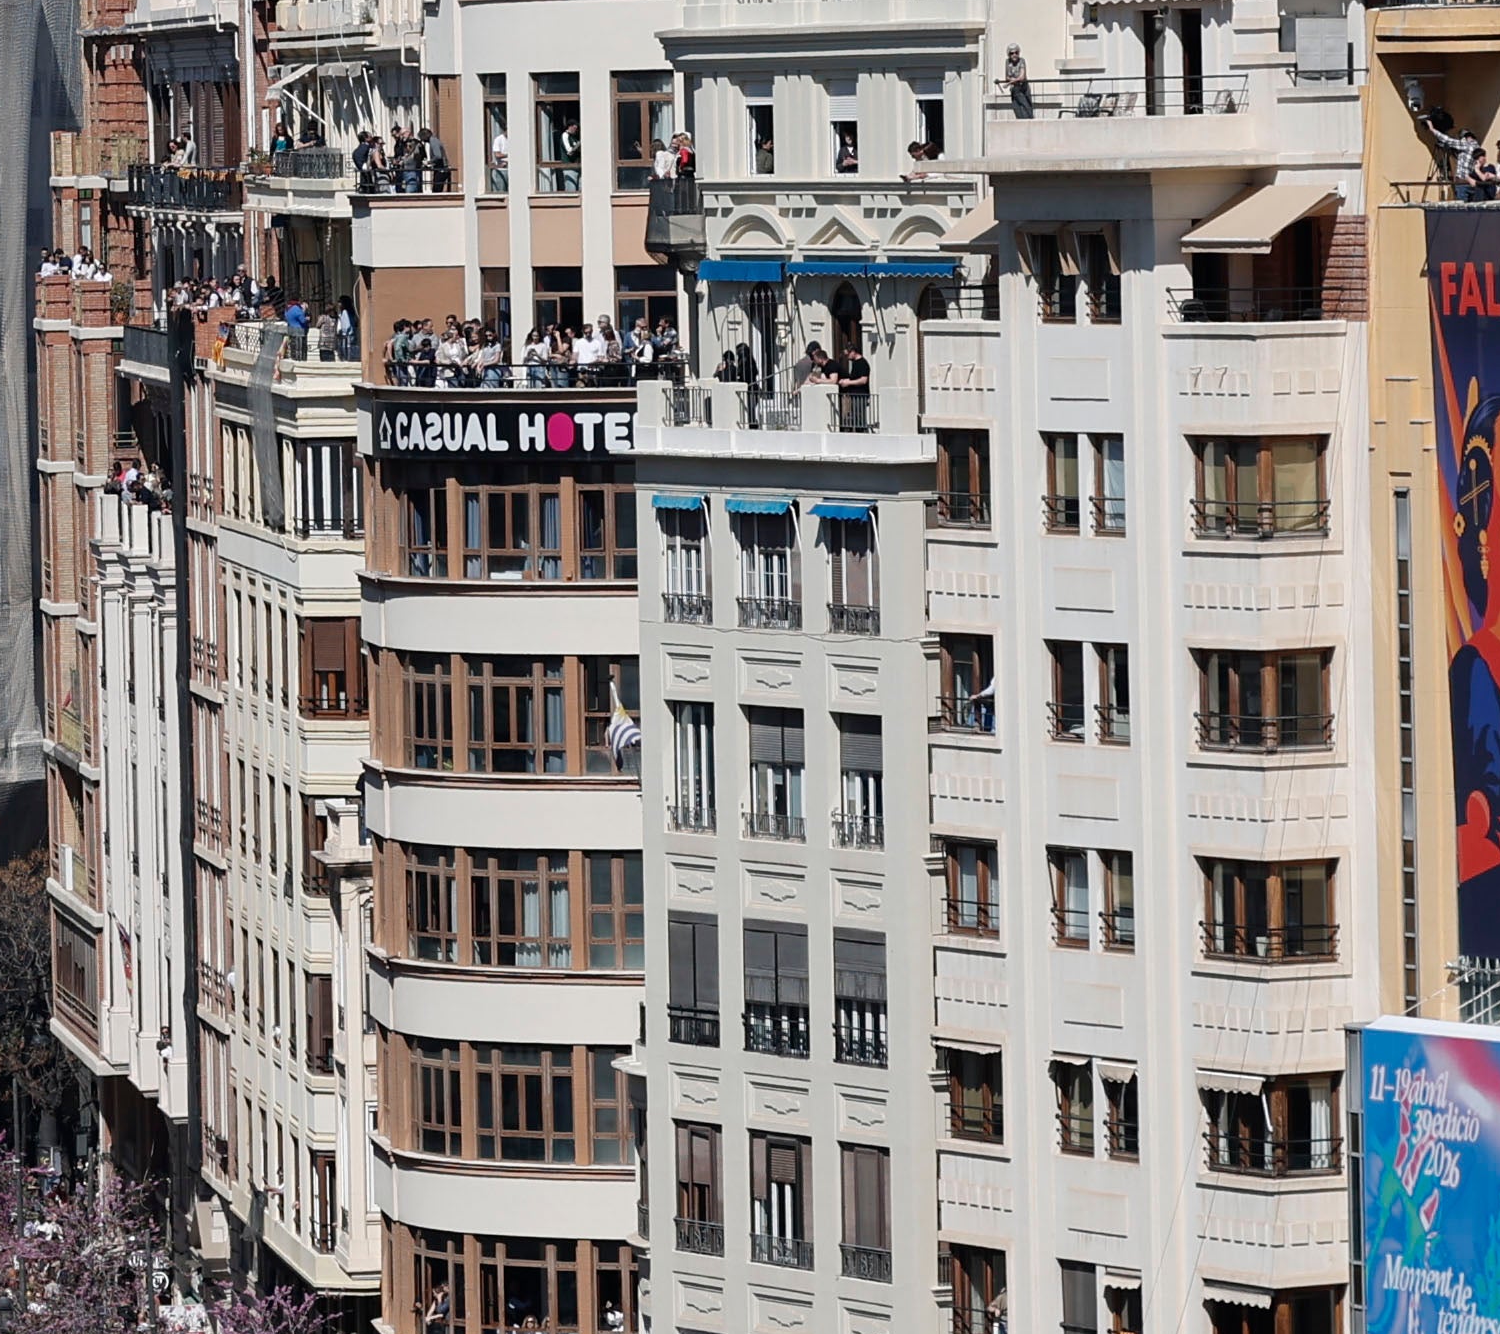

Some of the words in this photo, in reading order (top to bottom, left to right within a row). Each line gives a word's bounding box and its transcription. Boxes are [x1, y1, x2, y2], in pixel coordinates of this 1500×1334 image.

[395, 412, 507, 452] CASUAL
[1424, 1142, 1461, 1189] 2026
[1383, 1254, 1452, 1299] Moment
[1450, 1272, 1473, 1311] de
